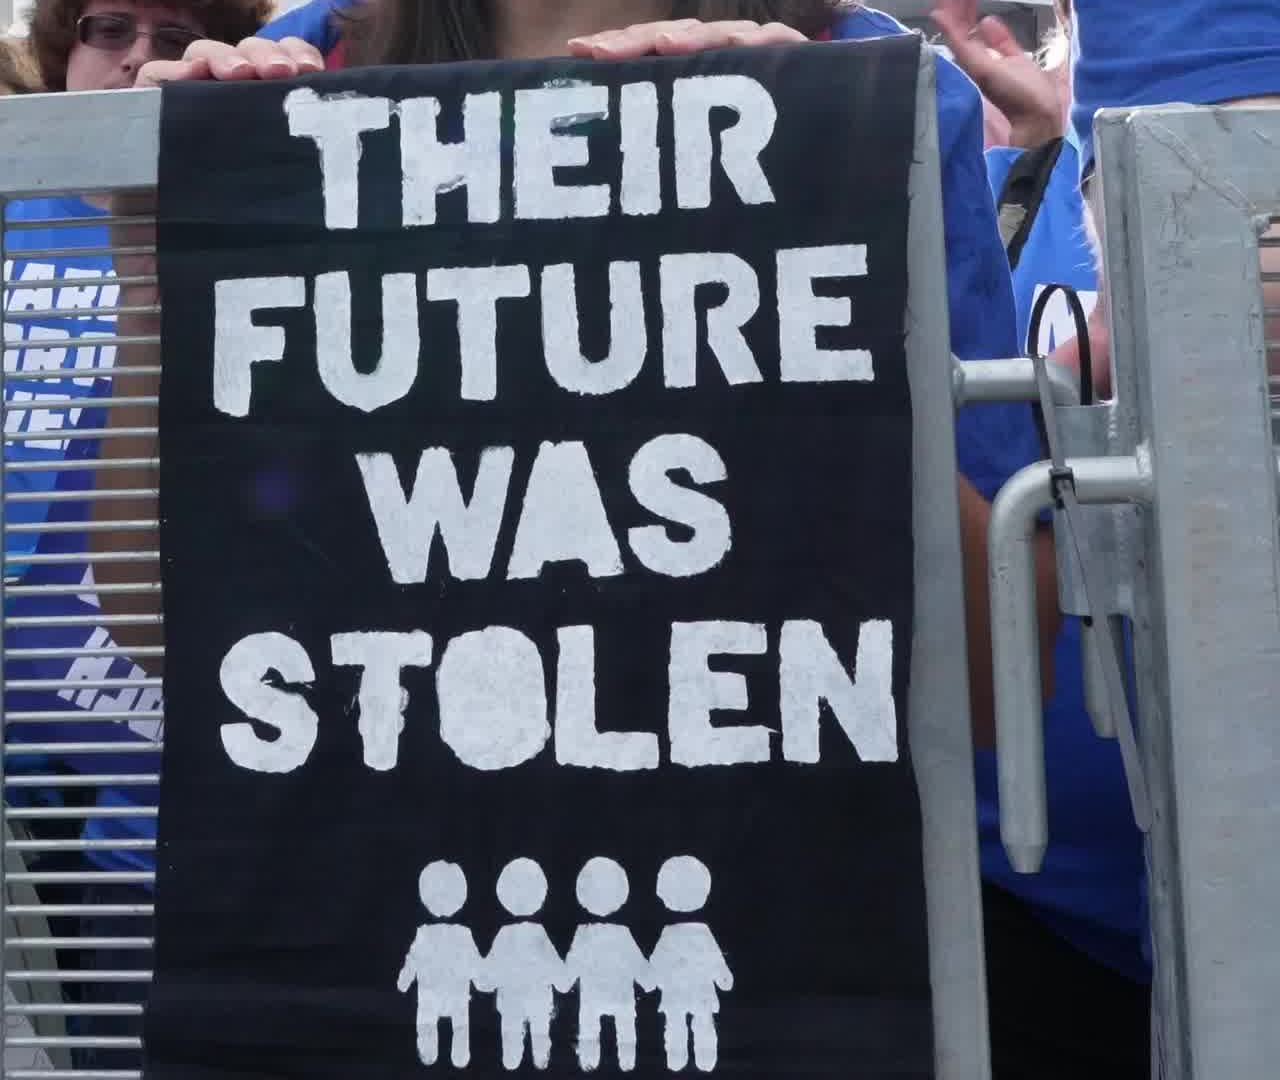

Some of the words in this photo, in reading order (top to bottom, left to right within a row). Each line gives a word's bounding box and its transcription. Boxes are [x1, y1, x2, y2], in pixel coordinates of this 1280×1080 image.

[283, 74, 777, 229] THEIR
[214, 244, 875, 417] FUTURE
[356, 433, 732, 584] WAS
[220, 619, 898, 773] STOLEN
